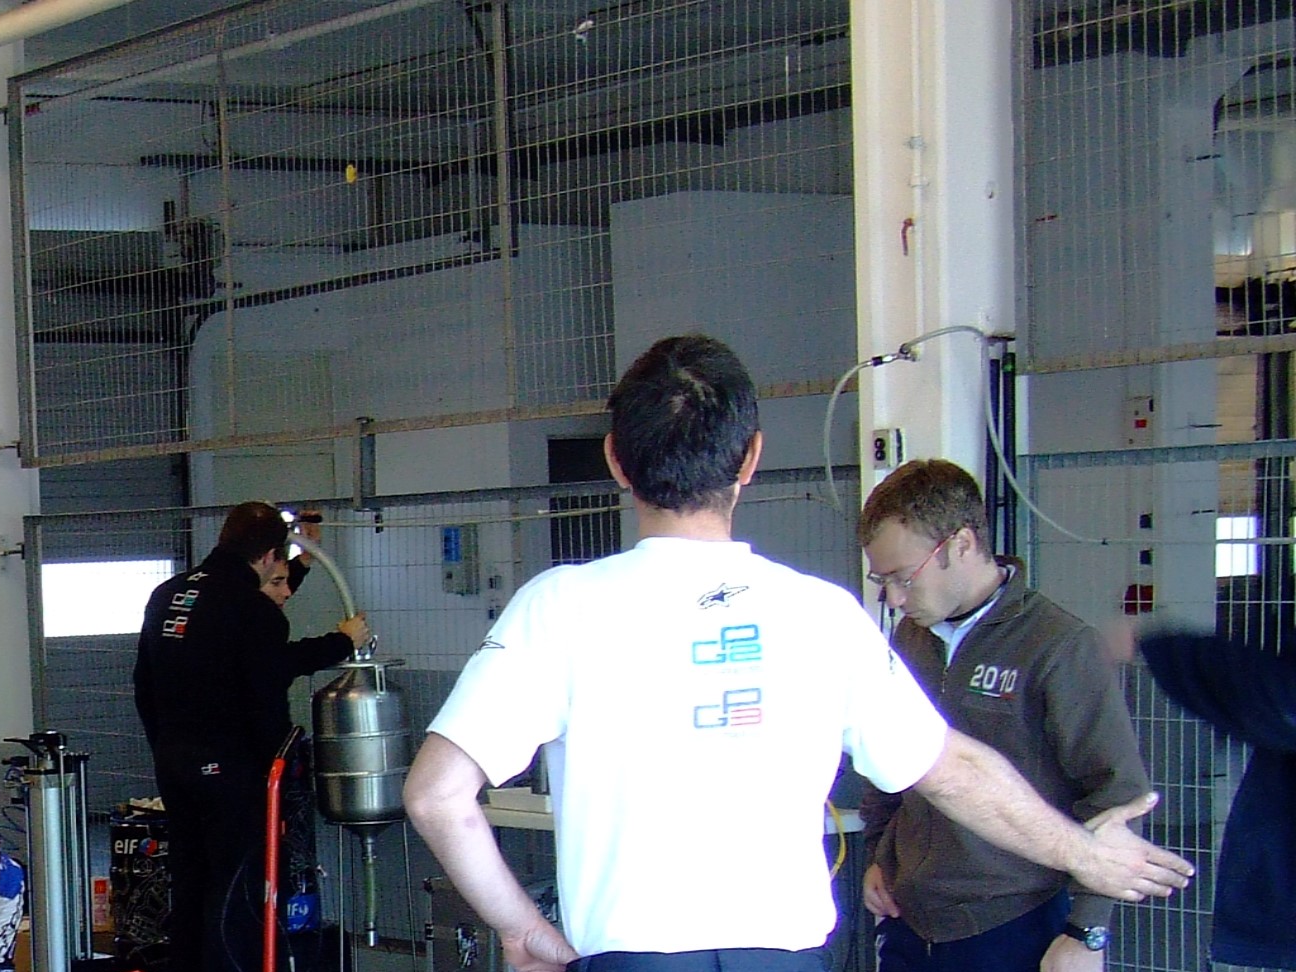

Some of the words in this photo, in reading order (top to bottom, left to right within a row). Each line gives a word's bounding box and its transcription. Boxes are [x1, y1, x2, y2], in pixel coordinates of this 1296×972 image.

[692, 623, 762, 664] GP2
[969, 664, 1018, 693] 2010
[693, 687, 762, 728] GP3
[114, 839, 138, 854] elf
